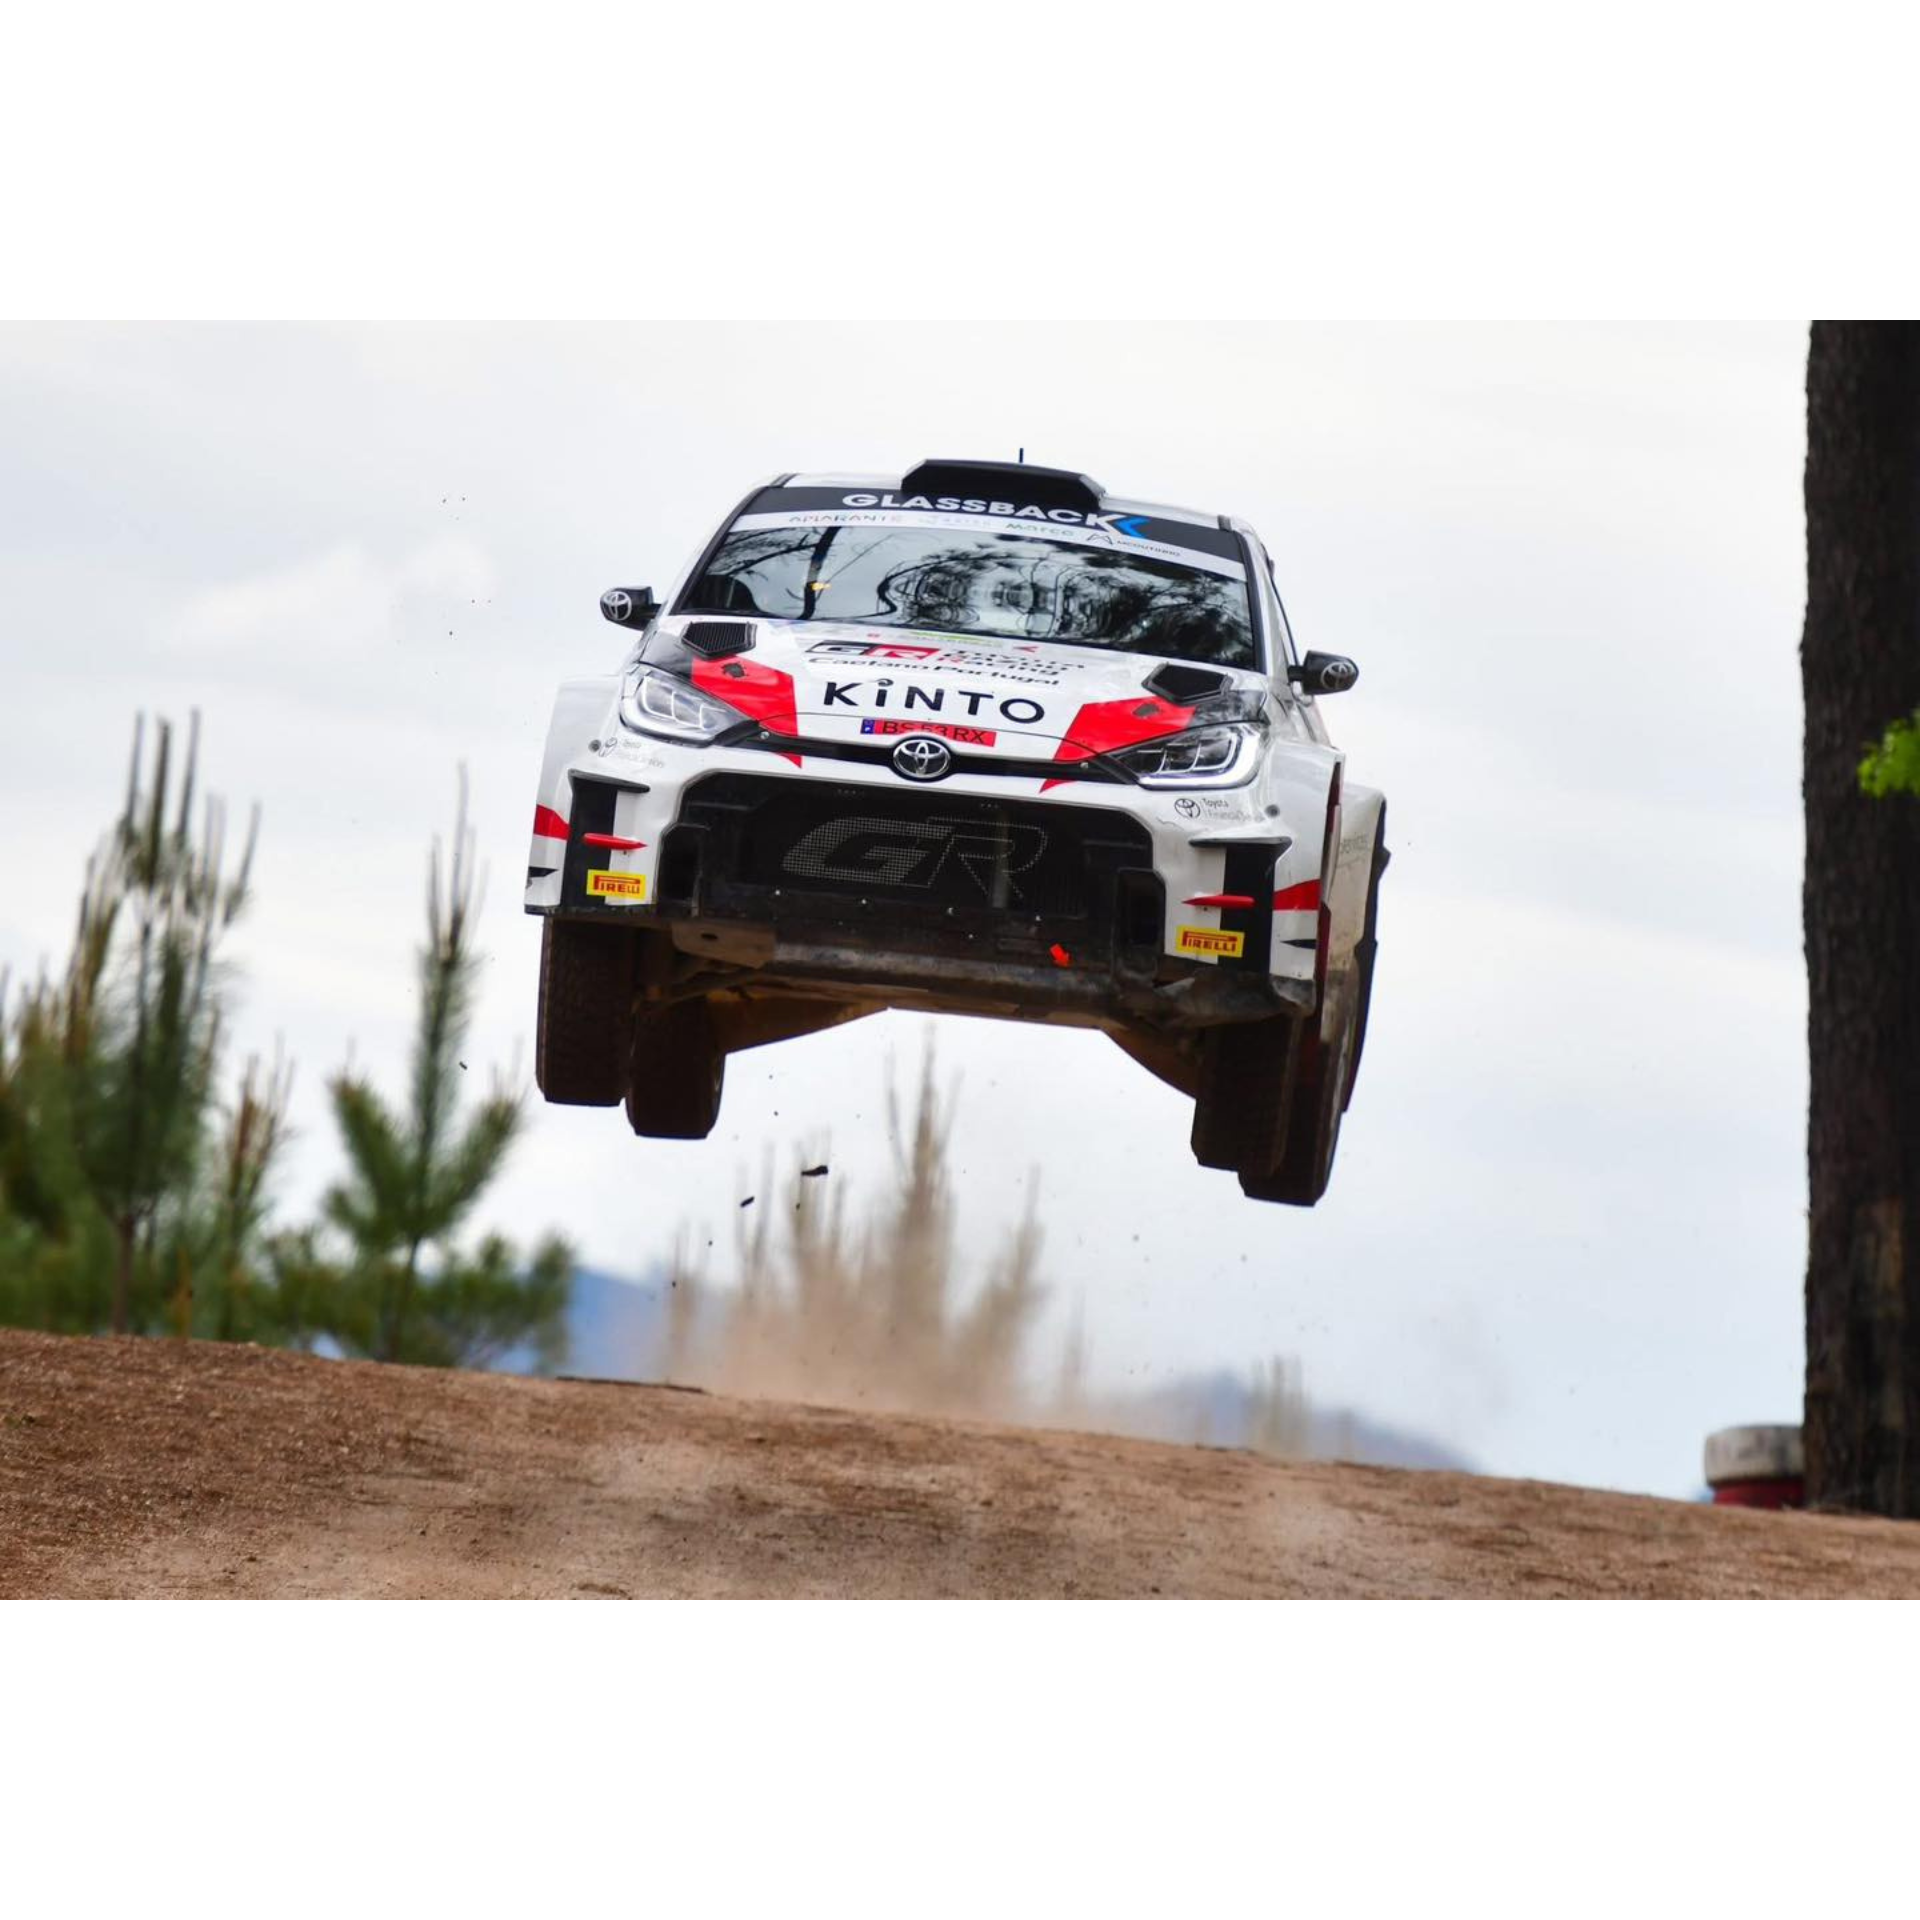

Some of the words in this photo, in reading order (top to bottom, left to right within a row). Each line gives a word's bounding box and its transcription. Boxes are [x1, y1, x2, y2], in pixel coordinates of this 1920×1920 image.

[842, 493, 1127, 535] GLASSBACK
[808, 657, 929, 671] Caetano
[933, 665, 1060, 686] Portugal
[952, 726, 986, 744] RX
[782, 816, 1048, 899] GR
[593, 875, 641, 894] PIRELLI
[1182, 931, 1238, 952] PIRELLI
